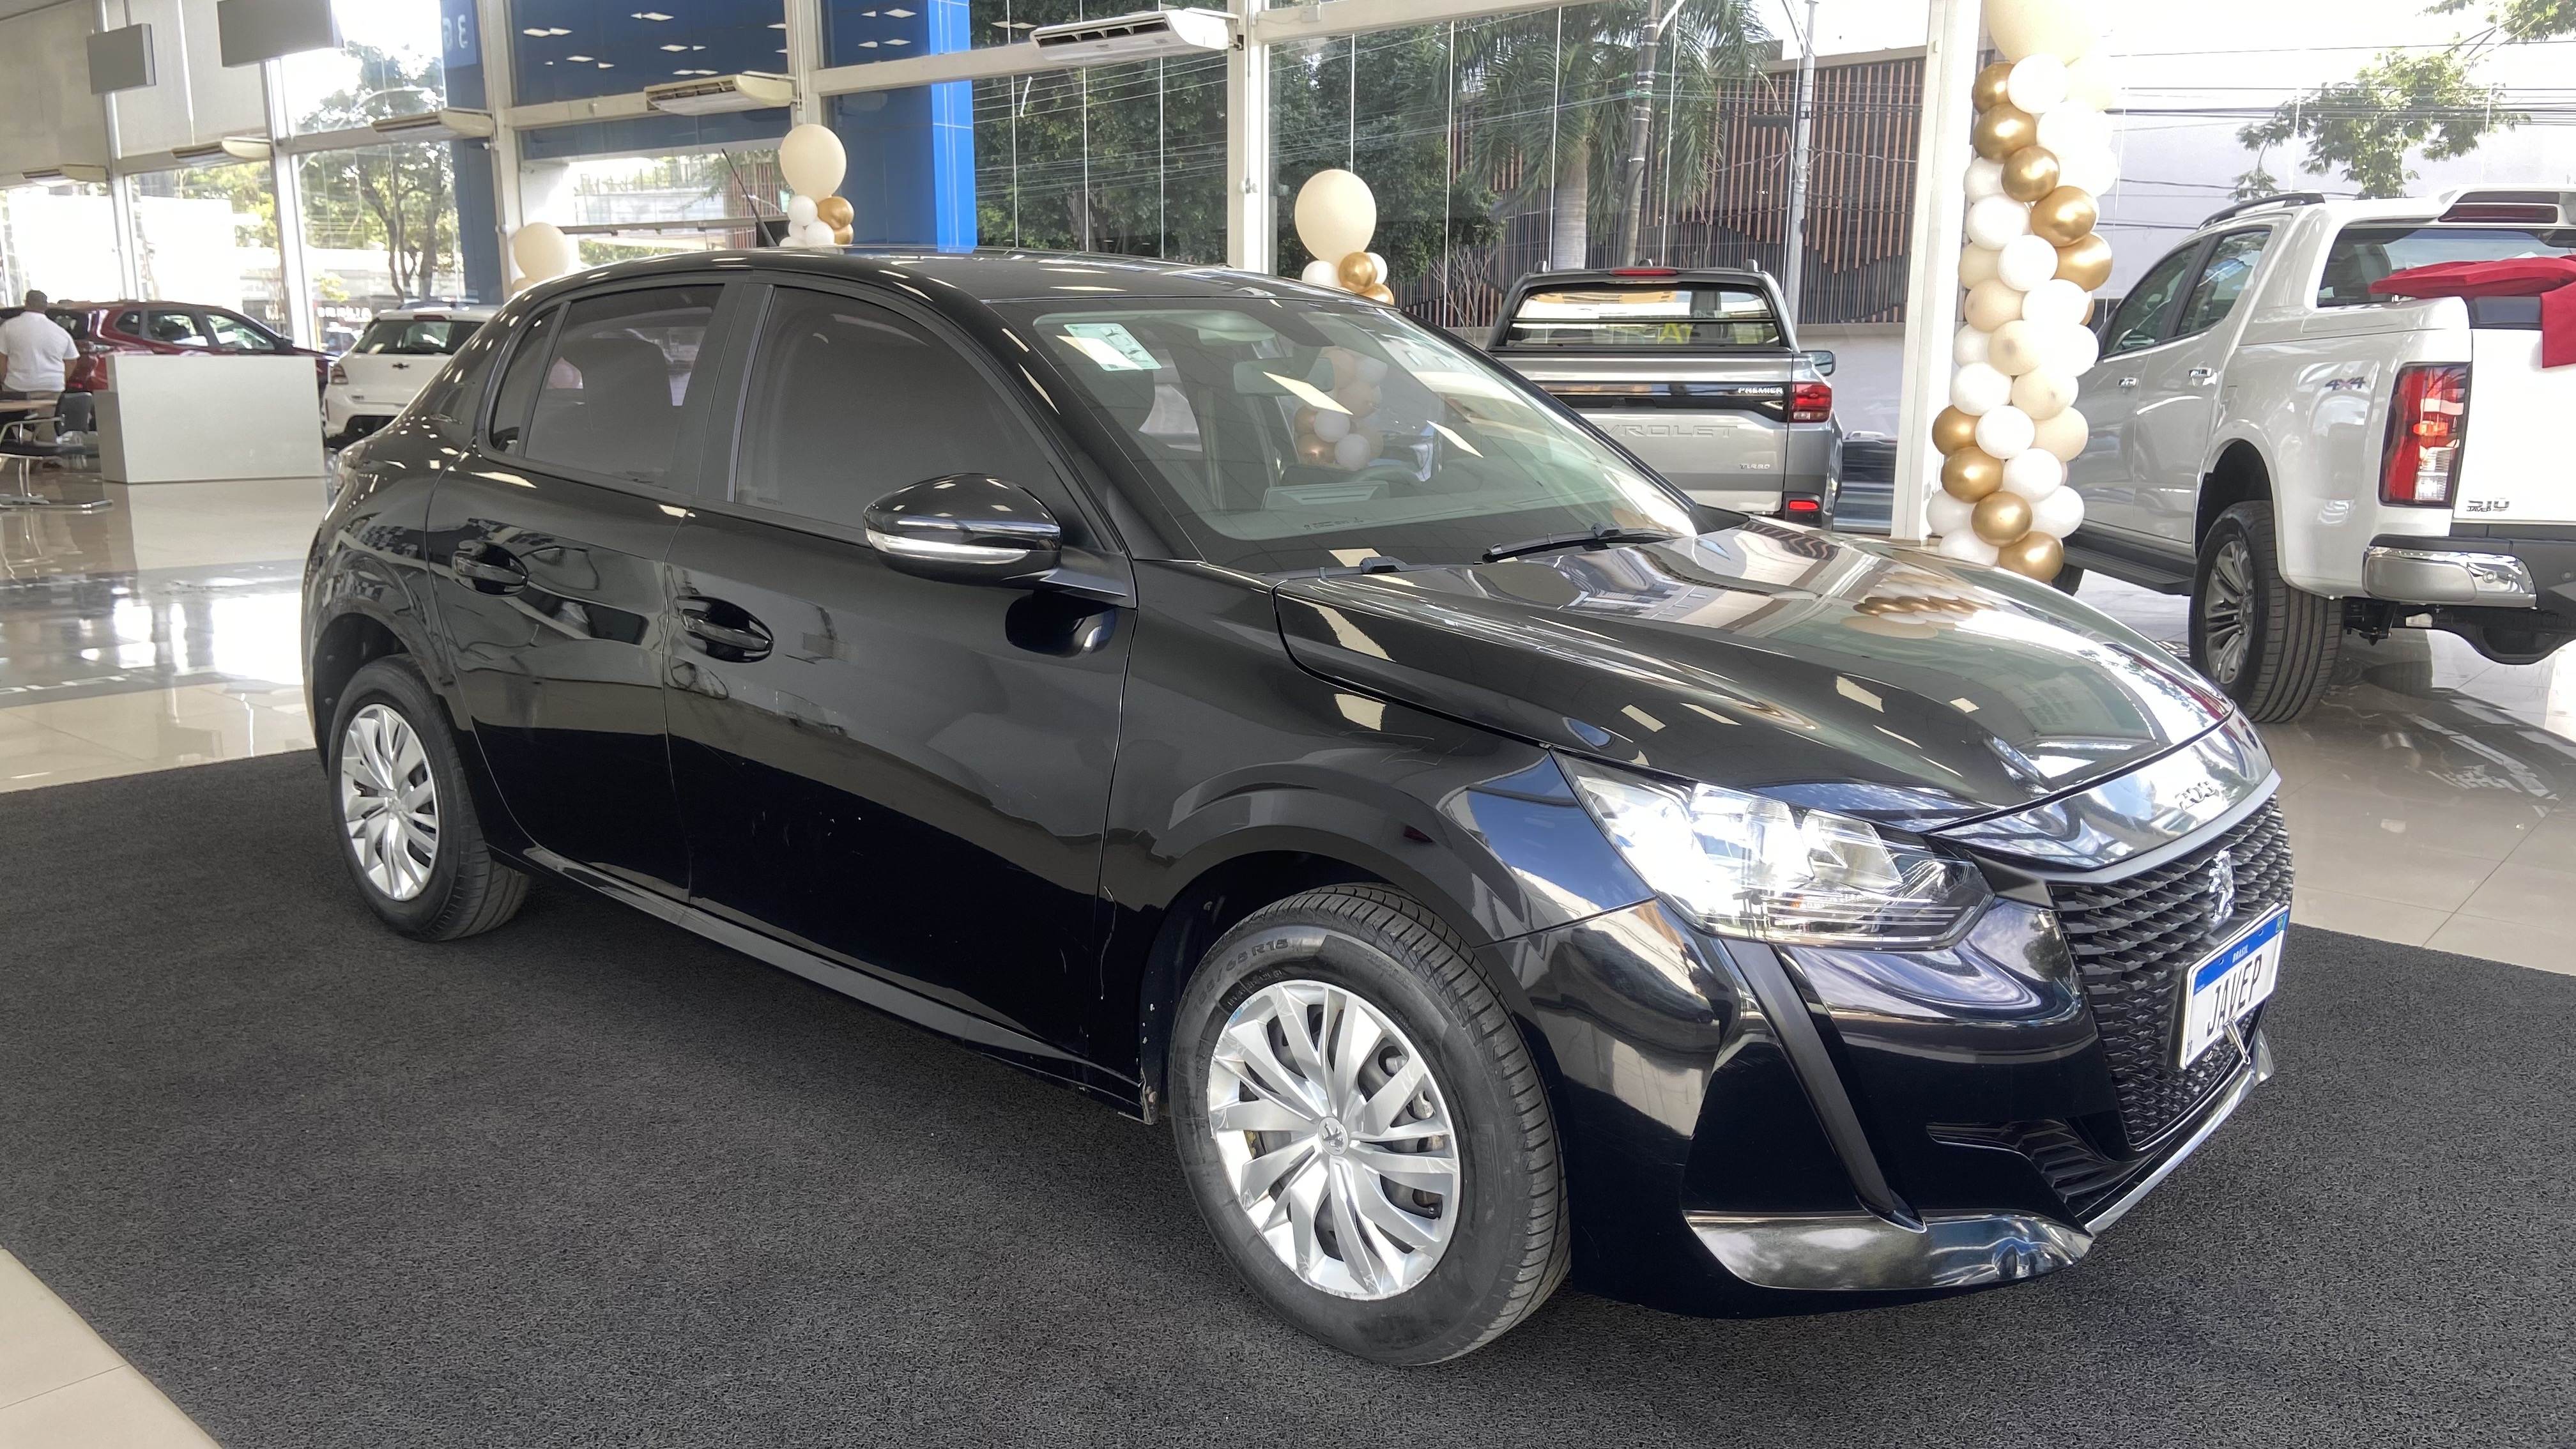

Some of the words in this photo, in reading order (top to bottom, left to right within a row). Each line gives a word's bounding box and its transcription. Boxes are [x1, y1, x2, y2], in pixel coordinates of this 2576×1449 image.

[1596, 424, 1738, 438] VROLET
[1251, 938, 1289, 956] R15
[2232, 944, 2248, 963] BRASIL
[2206, 953, 2262, 1038] JAVEP
